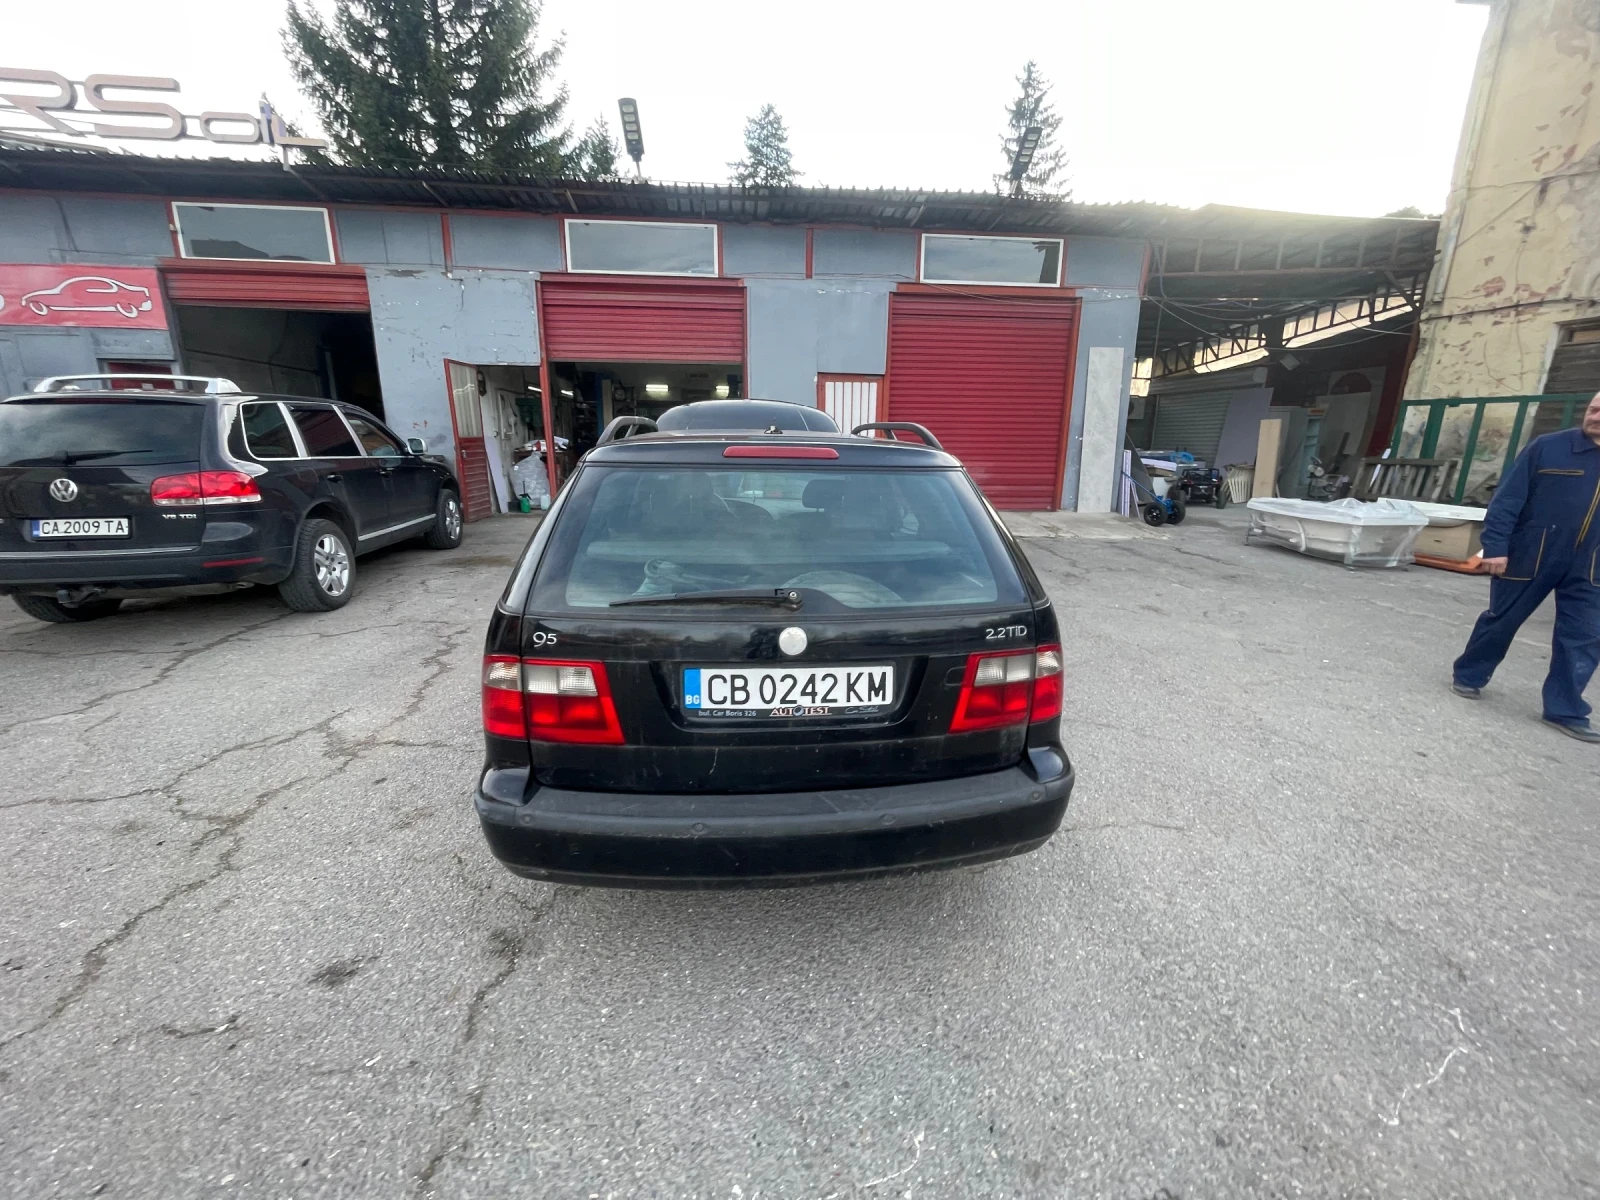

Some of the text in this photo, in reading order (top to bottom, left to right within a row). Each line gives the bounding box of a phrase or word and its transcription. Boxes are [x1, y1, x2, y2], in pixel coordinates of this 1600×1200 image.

[41, 520, 125, 534] CA 2009 TA
[707, 671, 887, 705] CB 0242 KM
[685, 694, 700, 705] BG
